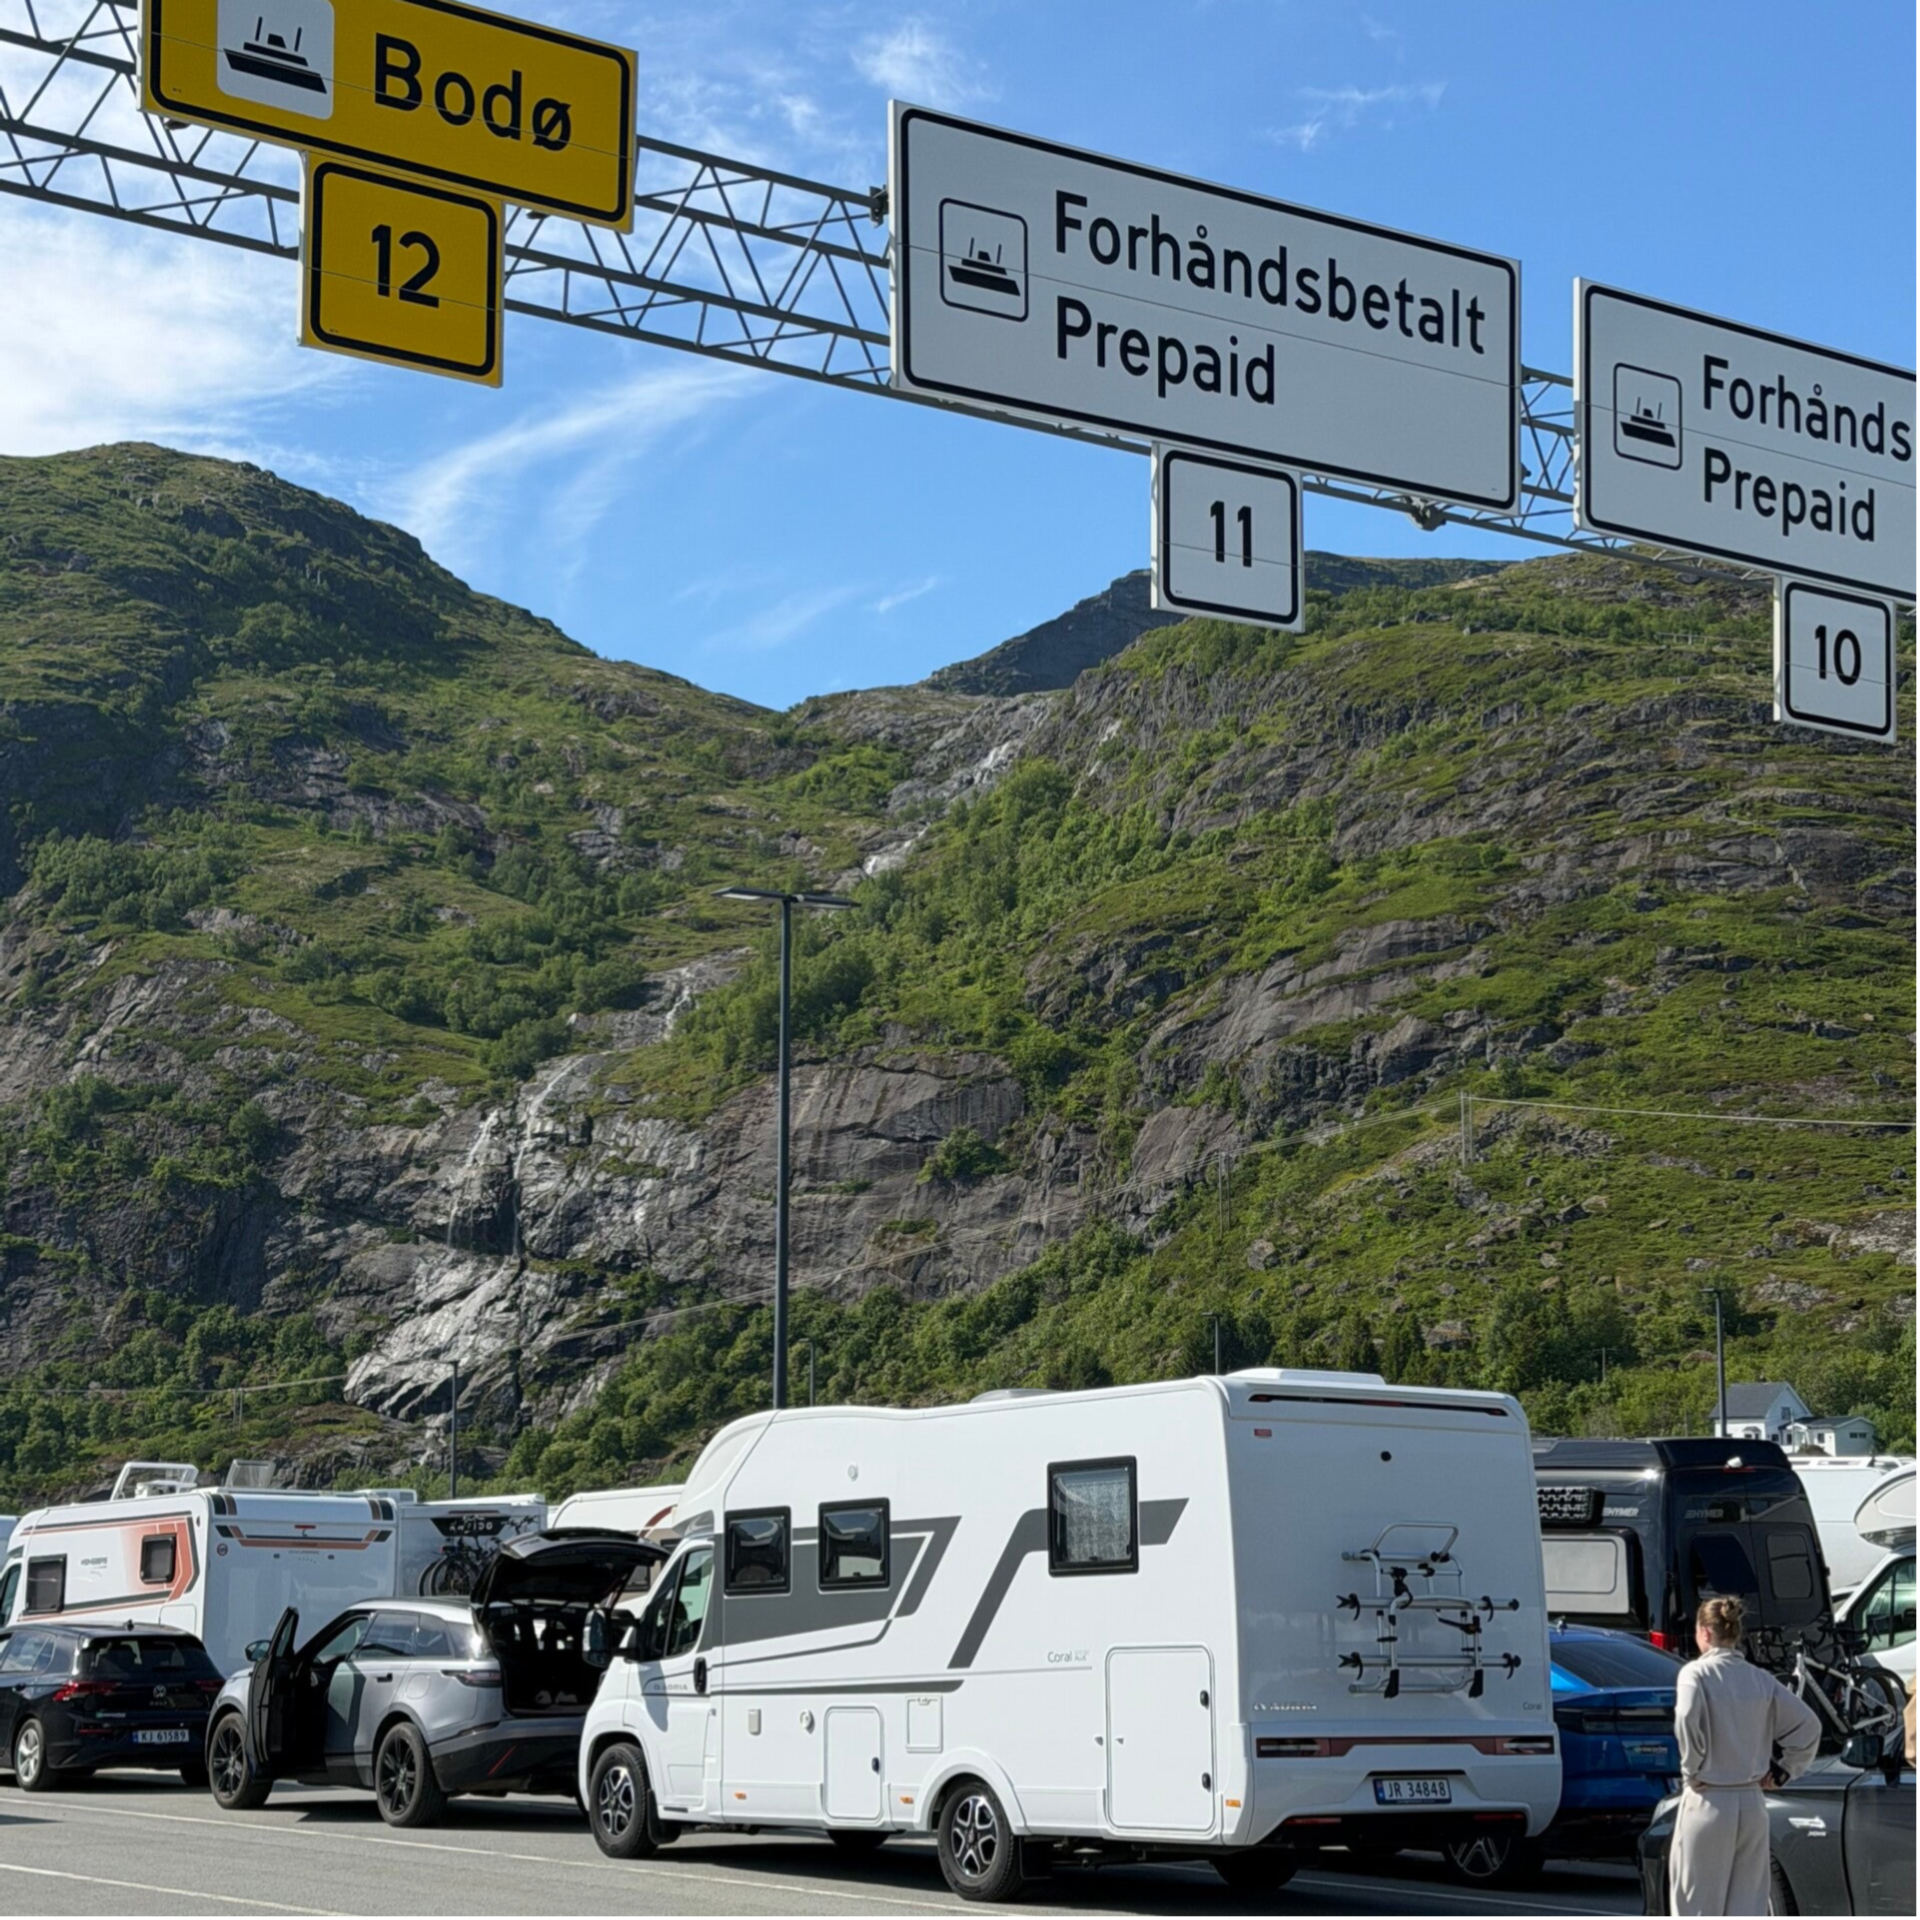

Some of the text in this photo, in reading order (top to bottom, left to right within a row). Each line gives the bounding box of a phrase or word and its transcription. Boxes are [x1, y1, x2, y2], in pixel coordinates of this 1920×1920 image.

[374, 32, 571, 152] Bodø
[371, 223, 441, 309] 12
[1056, 189, 1486, 355] Forhåndsbetalt
[1057, 295, 1276, 405] Prepaid
[1704, 447, 1876, 542] Prepaid
[1210, 500, 1252, 568] 11
[1815, 624, 1862, 686] 10
[1605, 1507, 1639, 1517] HYMER
[1689, 1509, 1724, 1518] HYMER
[1047, 1650, 1073, 1663] Coral
[141, 1730, 187, 1741] KJ 61589
[1522, 1701, 1543, 1711] Coral
[1388, 1781, 1447, 1798] JR 34848
